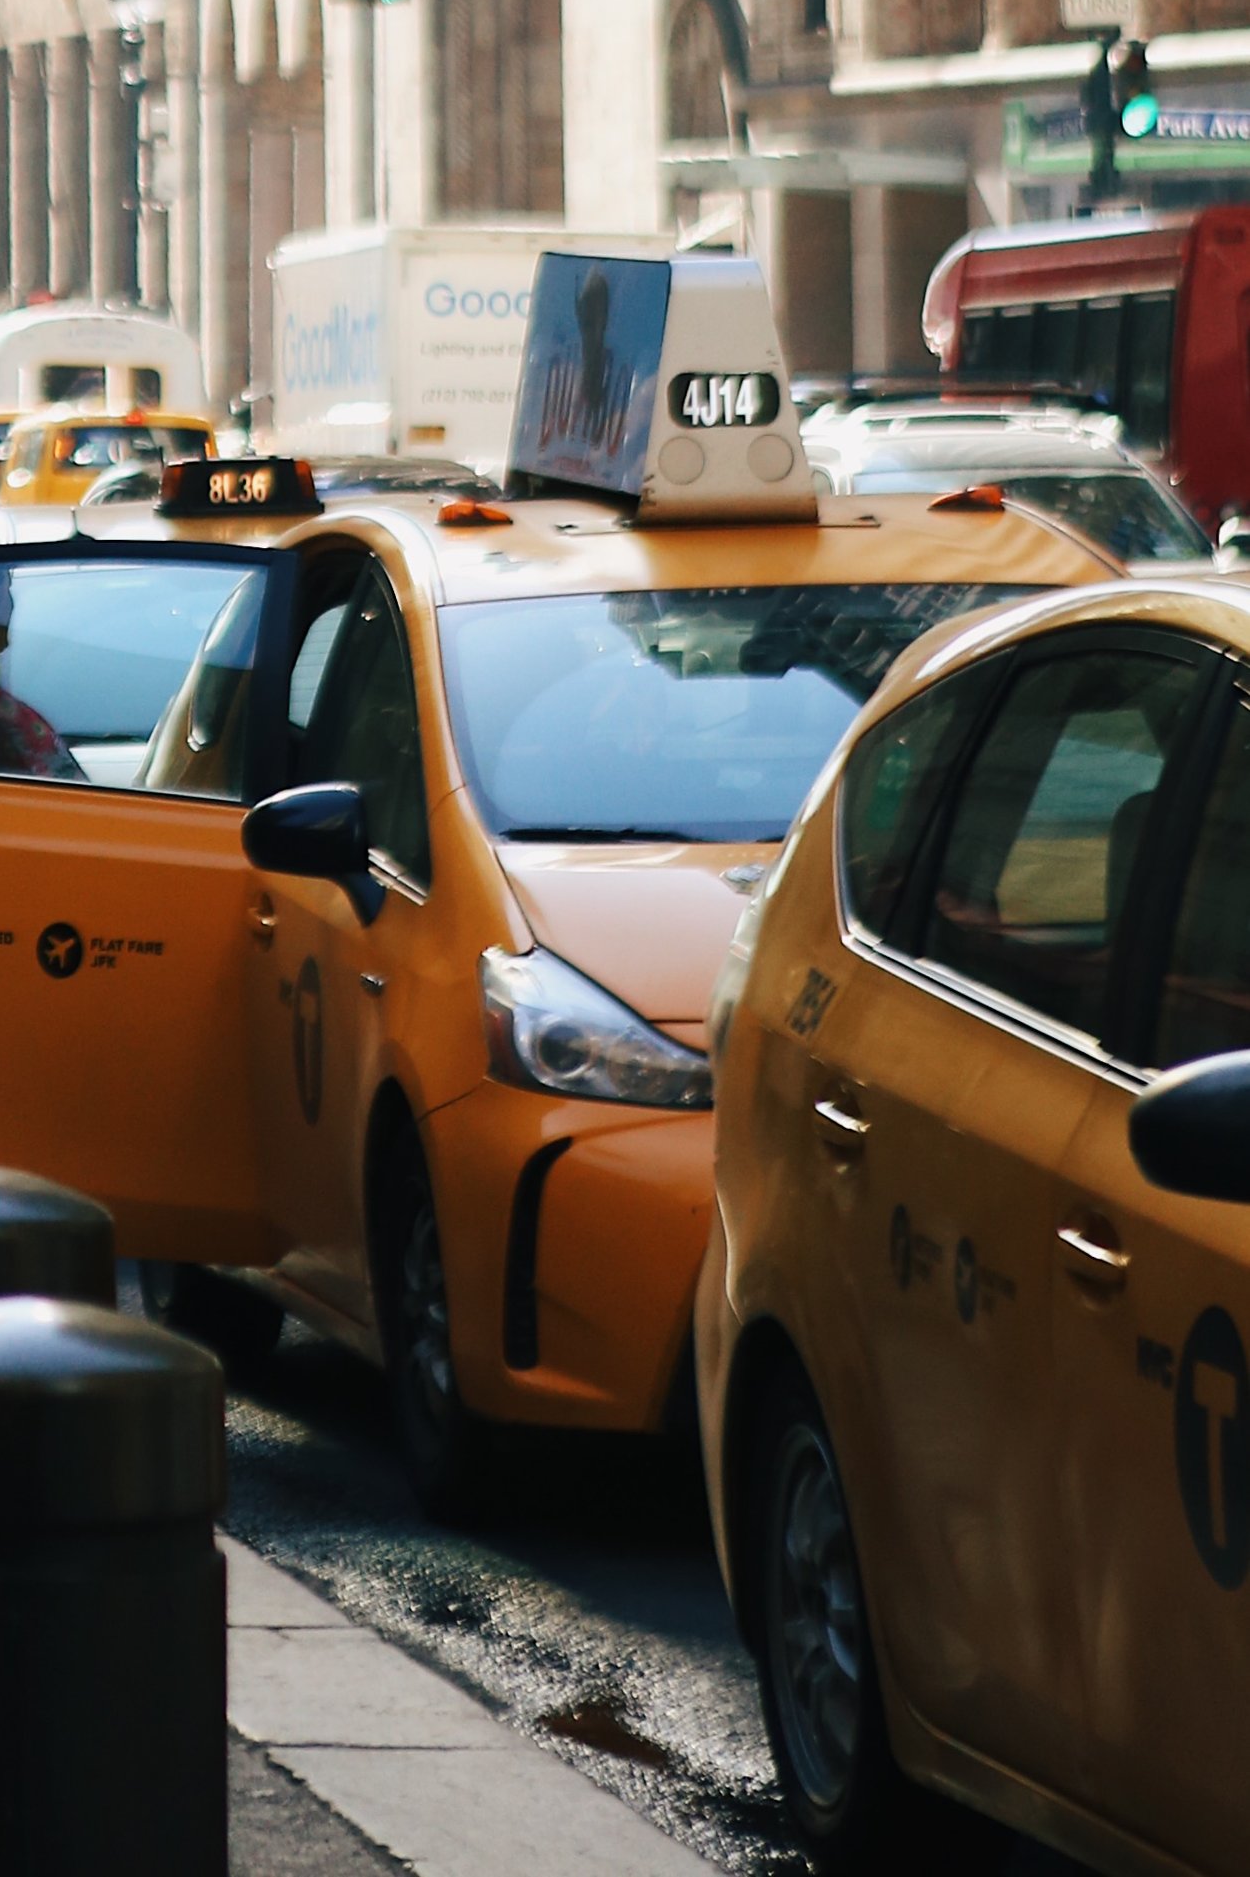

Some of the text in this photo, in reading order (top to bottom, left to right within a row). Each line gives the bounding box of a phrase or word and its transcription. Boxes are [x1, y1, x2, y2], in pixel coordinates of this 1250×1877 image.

[682, 376, 759, 427] 4J14
[209, 470, 274, 505] 8L36
[90, 937, 165, 957] FLAT FARE
